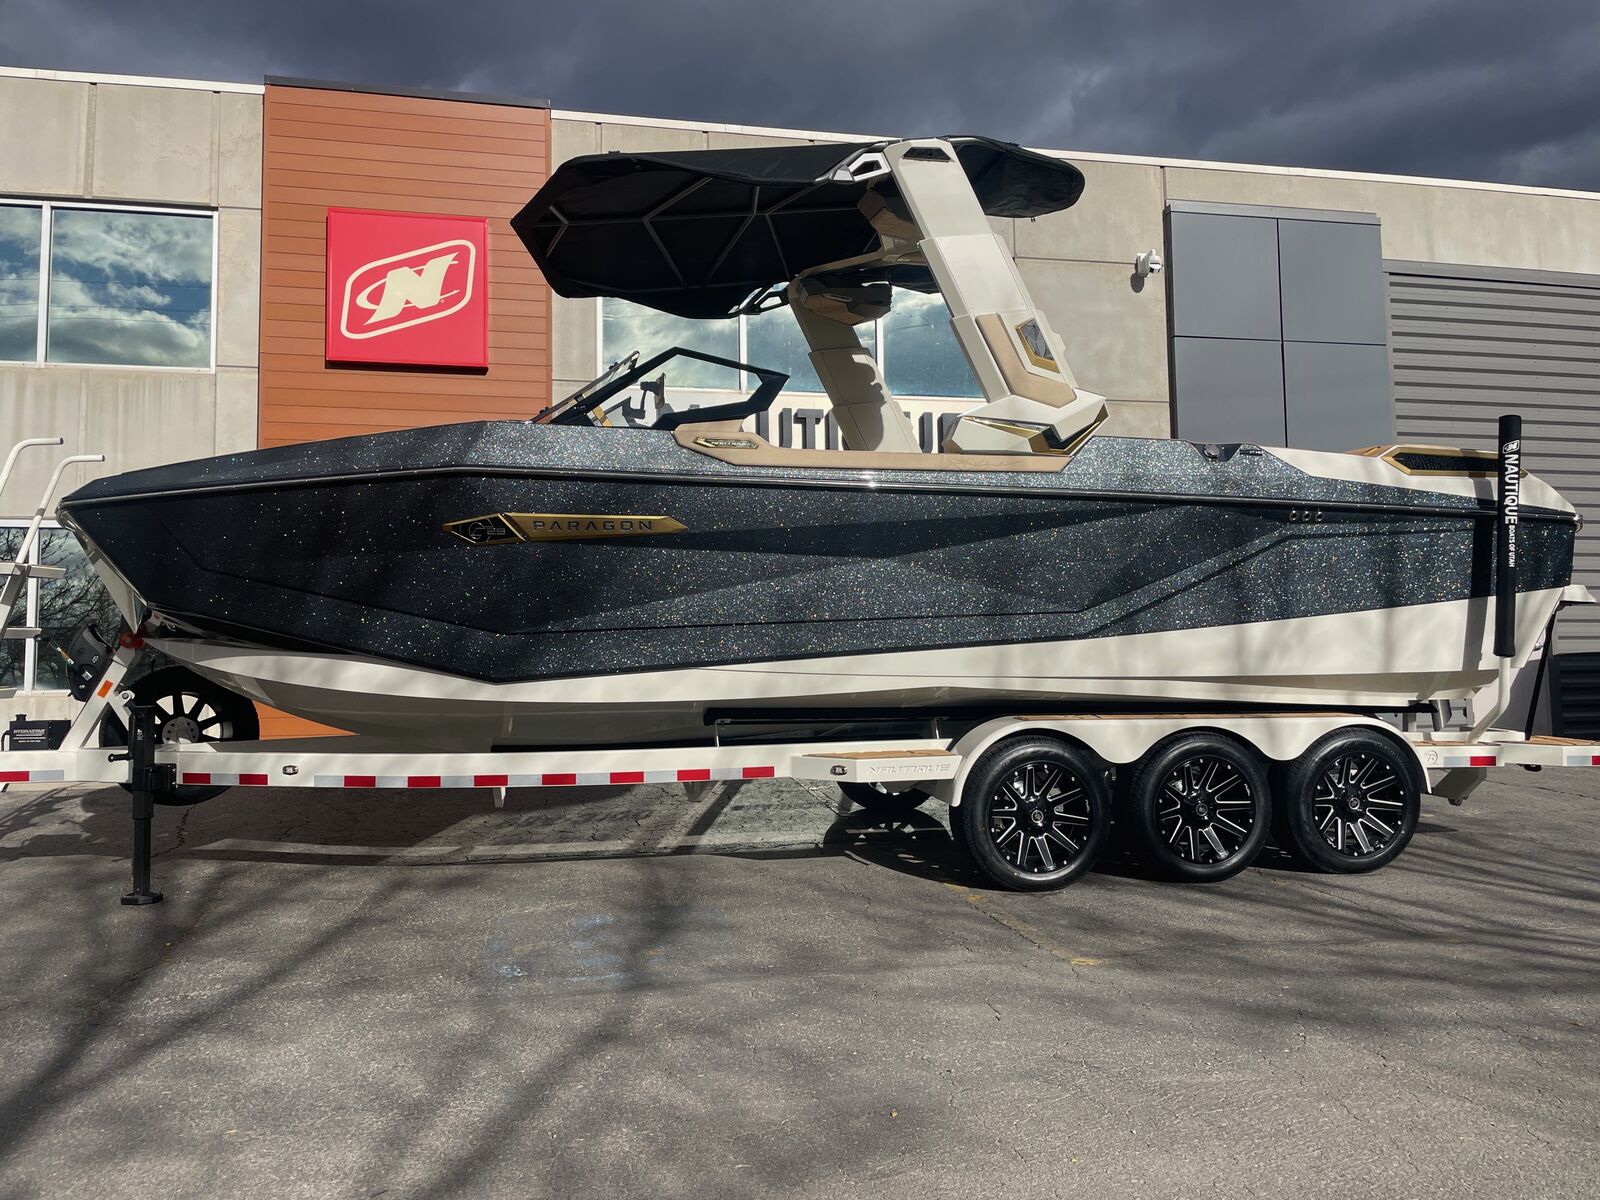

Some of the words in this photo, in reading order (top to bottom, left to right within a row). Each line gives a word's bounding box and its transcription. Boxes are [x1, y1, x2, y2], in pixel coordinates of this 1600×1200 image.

[1504, 454, 1519, 525] NAUTIQUE
[533, 521, 652, 532] PARAGON
[1508, 524, 1516, 543] BOATS
[1508, 543, 1516, 552] OF
[1508, 552, 1516, 568] UTAH
